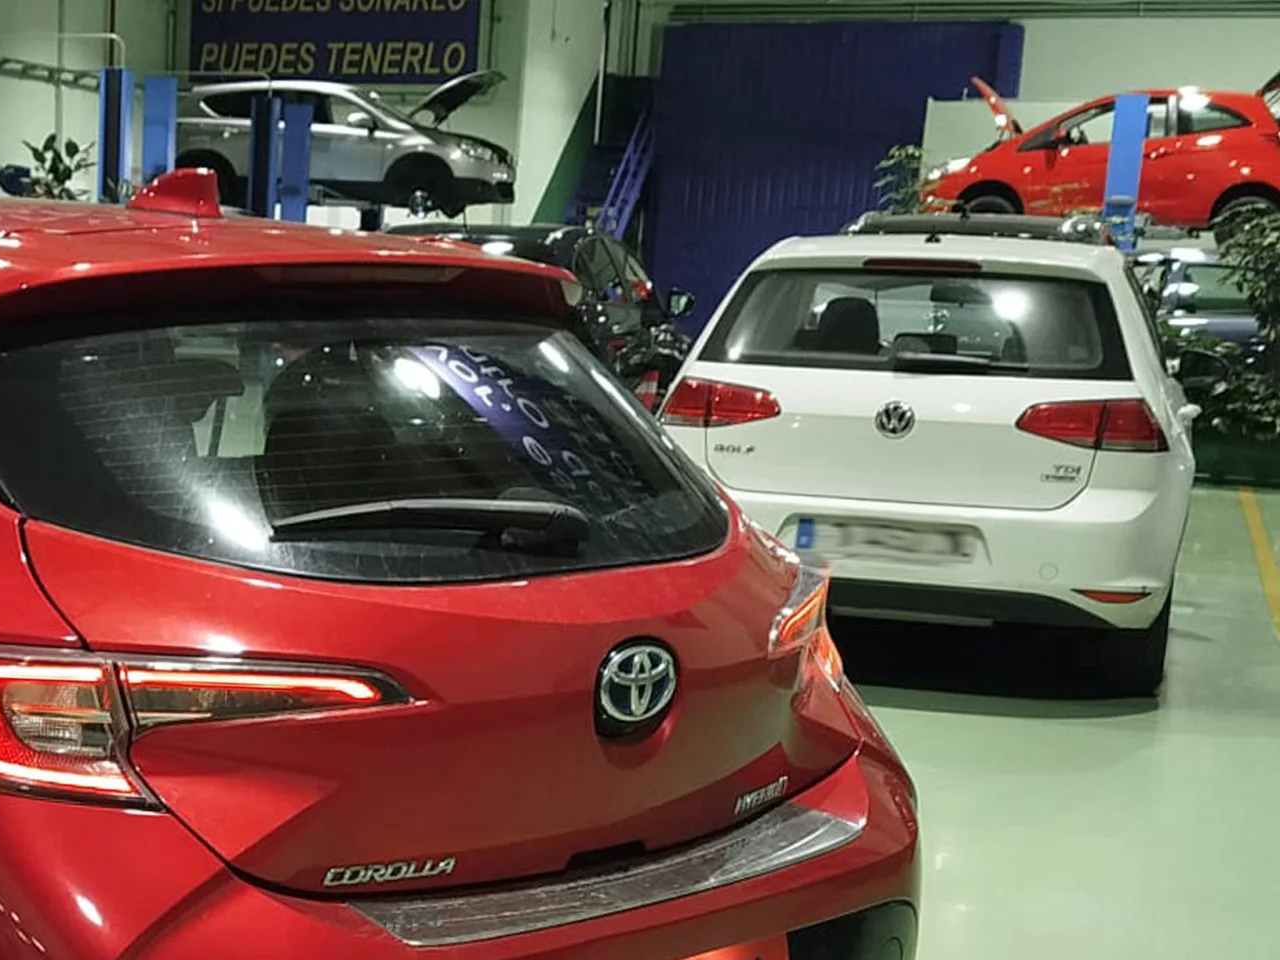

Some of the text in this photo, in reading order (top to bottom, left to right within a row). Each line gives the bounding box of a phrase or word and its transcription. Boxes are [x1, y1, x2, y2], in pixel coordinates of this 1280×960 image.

[199, 42, 467, 76] PUEDES TENERLO
[323, 856, 457, 887] COROLLA
